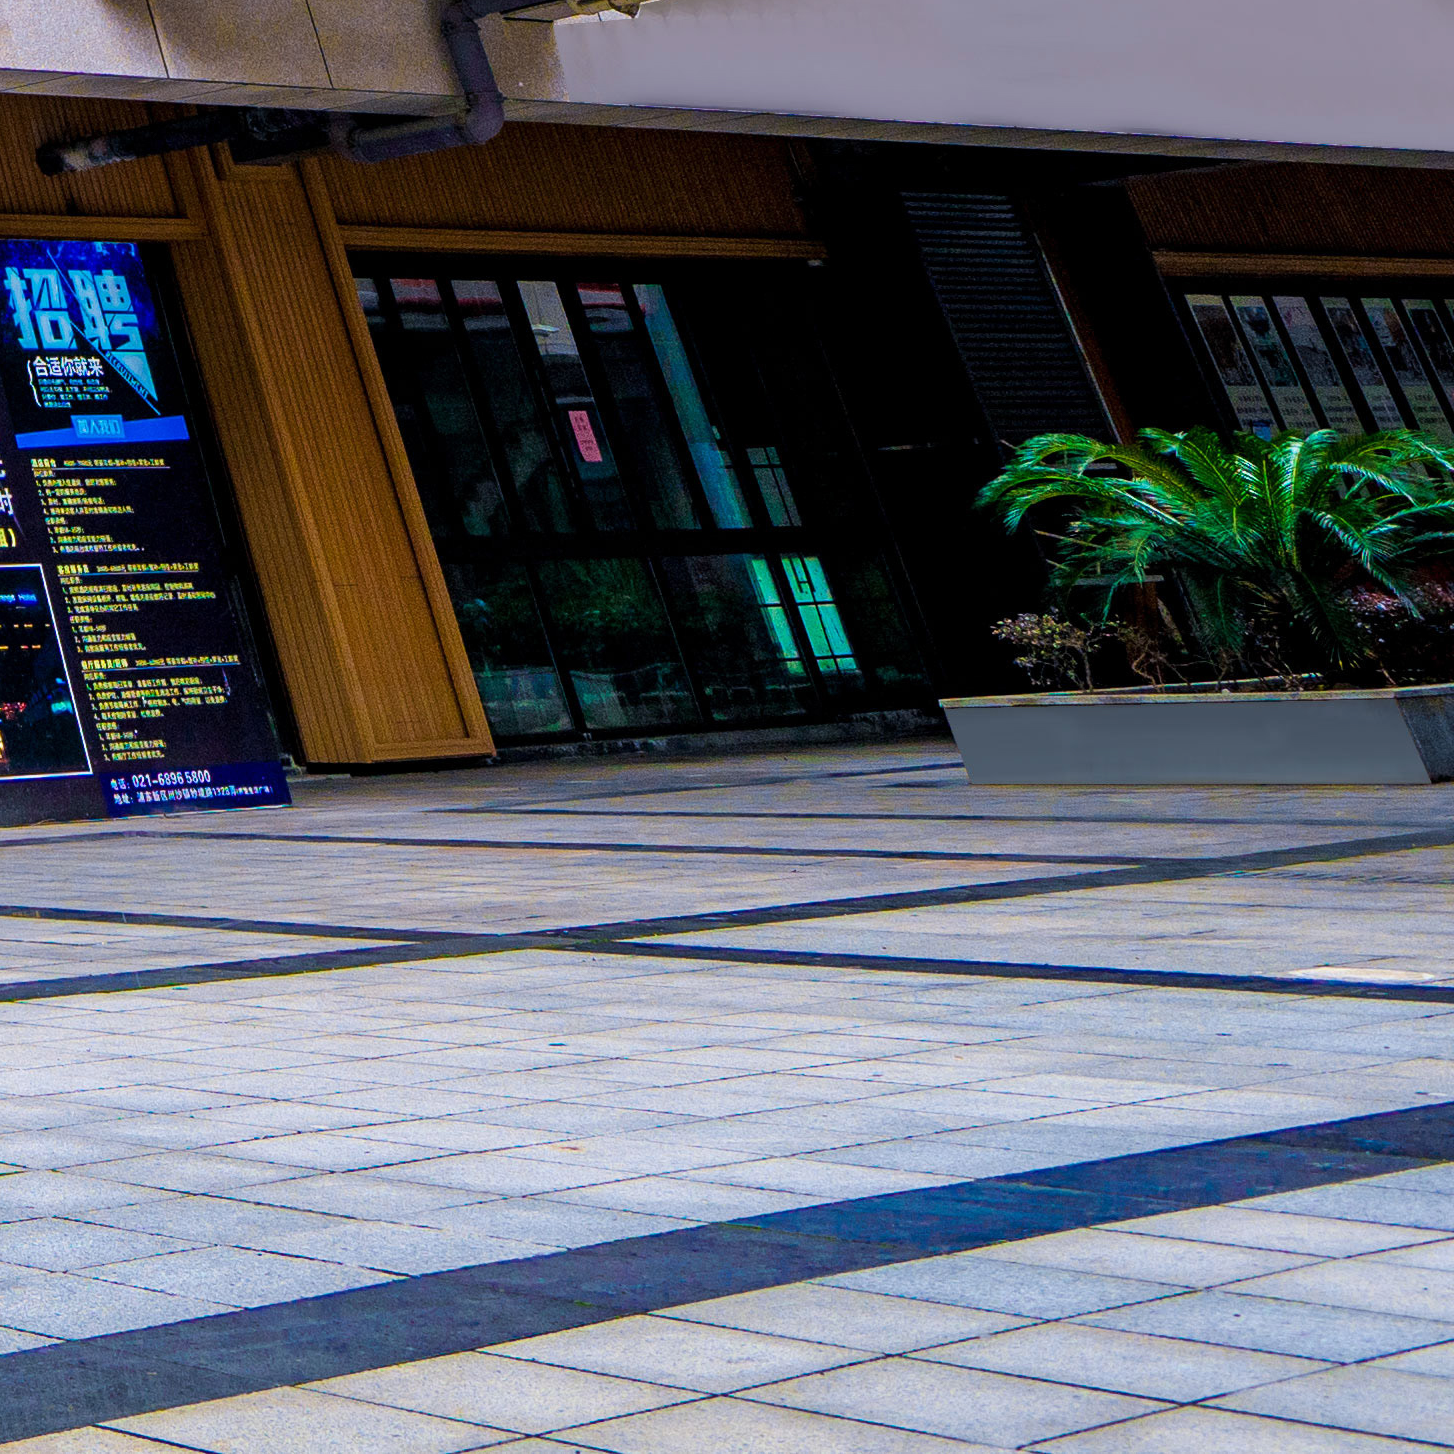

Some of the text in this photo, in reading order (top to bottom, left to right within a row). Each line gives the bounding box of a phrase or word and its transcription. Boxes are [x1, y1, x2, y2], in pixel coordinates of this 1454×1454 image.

[4, 266, 146, 362] 招聘
[33, 356, 105, 377] 合适你就来
